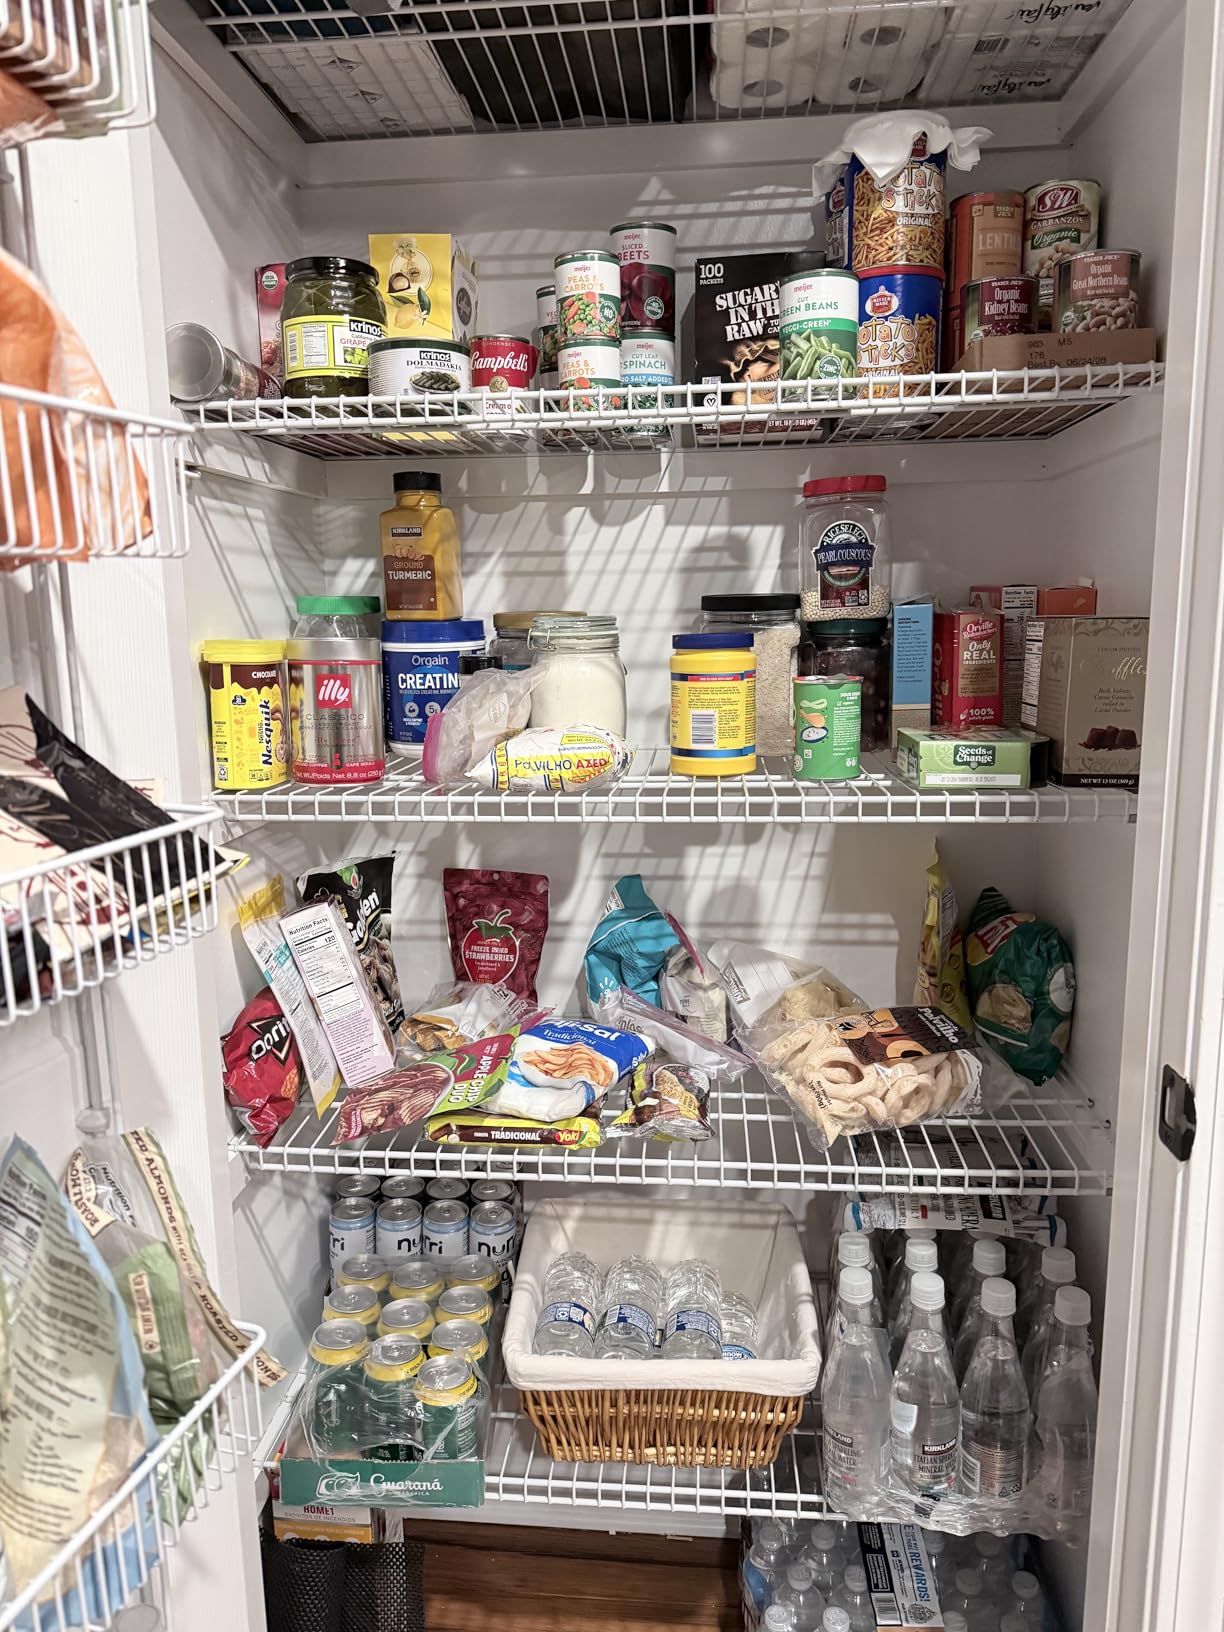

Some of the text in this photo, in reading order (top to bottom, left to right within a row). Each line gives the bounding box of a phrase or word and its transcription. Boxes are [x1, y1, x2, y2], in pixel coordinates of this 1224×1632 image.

[896, 217, 932, 227] ORIGINAL
[1031, 216, 1083, 230] GARBANZOS
[1033, 228, 1079, 247] Organic
[621, 243, 643, 251] SLICED
[573, 265, 591, 273] meijer
[700, 263, 724, 278] 100
[1090, 262, 1112, 274] Organic
[567, 275, 589, 284] PEAS
[1072, 274, 1128, 290] Great Northern Beans
[563, 283, 605, 293] CARROTS
[793, 283, 813, 293] meijer
[994, 287, 1021, 301] Organic
[715, 282, 779, 312] SUGAR
[797, 296, 809, 304] CUT
[728, 300, 780, 325] IN TH
[804, 301, 839, 312] BEANS
[984, 300, 1028, 316] Kidney Beans
[339, 338, 367, 347] GRAPE
[406, 359, 462, 371] DOLMADAKIA
[471, 351, 528, 373] Campbell's
[562, 360, 590, 370] PEAS &
[623, 360, 666, 370] SPINACH
[561, 367, 596, 379] CARROTS
[822, 364, 837, 373] ZINC
[837, 548, 872, 561] COUSCOUS
[394, 561, 423, 569] GROUND
[388, 570, 432, 580] TURMERIC
[966, 621, 993, 633] Orville
[969, 640, 991, 651] Only
[963, 650, 996, 659] REAL
[411, 654, 449, 668] Orgain
[398, 673, 461, 689] CREATIN
[318, 678, 350, 706] illy
[969, 707, 995, 716] 100%
[259, 699, 273, 766] Nesquik
[958, 745, 987, 755] Seeds
[956, 753, 993, 763] Change
[289, 918, 328, 936] Nutrition Facts
[324, 935, 336, 943] 120
[465, 951, 515, 962] STRAWBERRIES
[918, 1006, 959, 1044] Polvilho
[543, 1029, 597, 1045] Tradicional
[465, 1054, 488, 1102] APPLE CHIP
[449, 1082, 466, 1103] DUO
[490, 1130, 541, 1141] TRADICIONAL
[558, 1130, 581, 1142] Yoki
[101, 1166, 131, 1212] Nutrition
[144, 1156, 176, 1225] ALMONDS
[199, 1293, 239, 1339] ROASTED
[826, 1430, 852, 1444] RKLAND
[924, 1439, 956, 1452] KIRKLAND
[914, 1454, 938, 1465] ITALIAN
[918, 1464, 944, 1474] MINERAL
[370, 1473, 443, 1497] Guaraná
[303, 1505, 335, 1516] HOME1
[909, 1551, 931, 1603] REWARDS!
